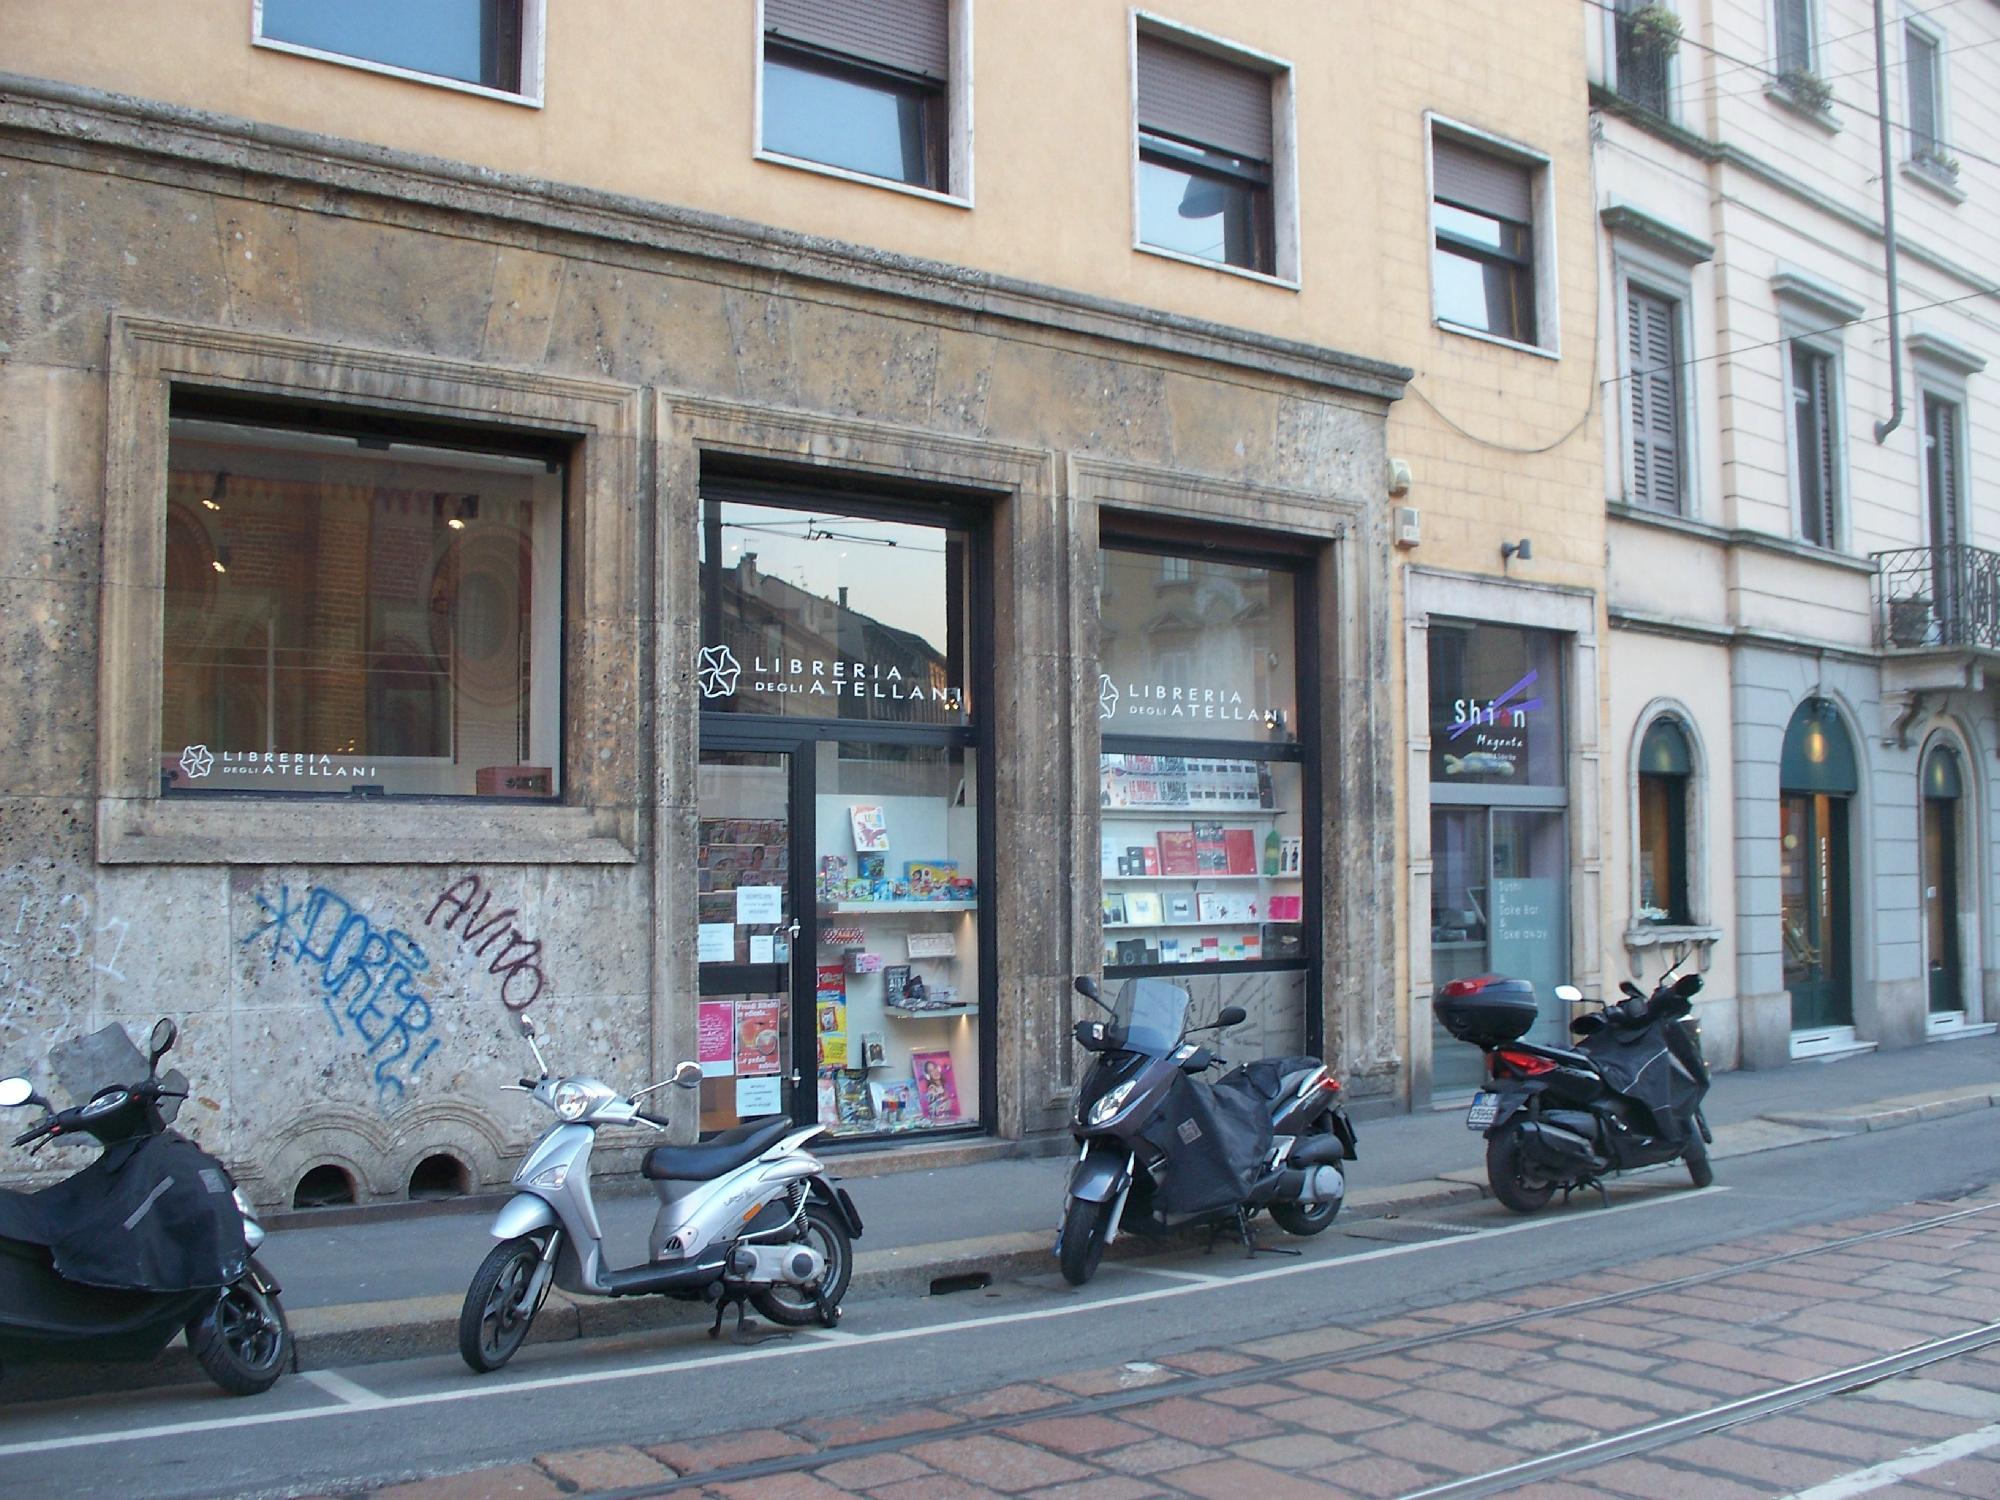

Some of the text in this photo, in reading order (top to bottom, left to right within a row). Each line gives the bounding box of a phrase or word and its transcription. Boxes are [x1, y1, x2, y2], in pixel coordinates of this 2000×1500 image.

[754, 656, 902, 681] LIBRERIA
[754, 679, 962, 703] DEGLI ATELLANI
[1128, 685, 1242, 704] LIBRERIA
[1129, 703, 1288, 723] DEGLI ATELLANI
[1476, 733, 1524, 751] Magenta
[223, 751, 331, 764] LIBRERIA
[223, 764, 377, 777] DEGLI ATELLANI
